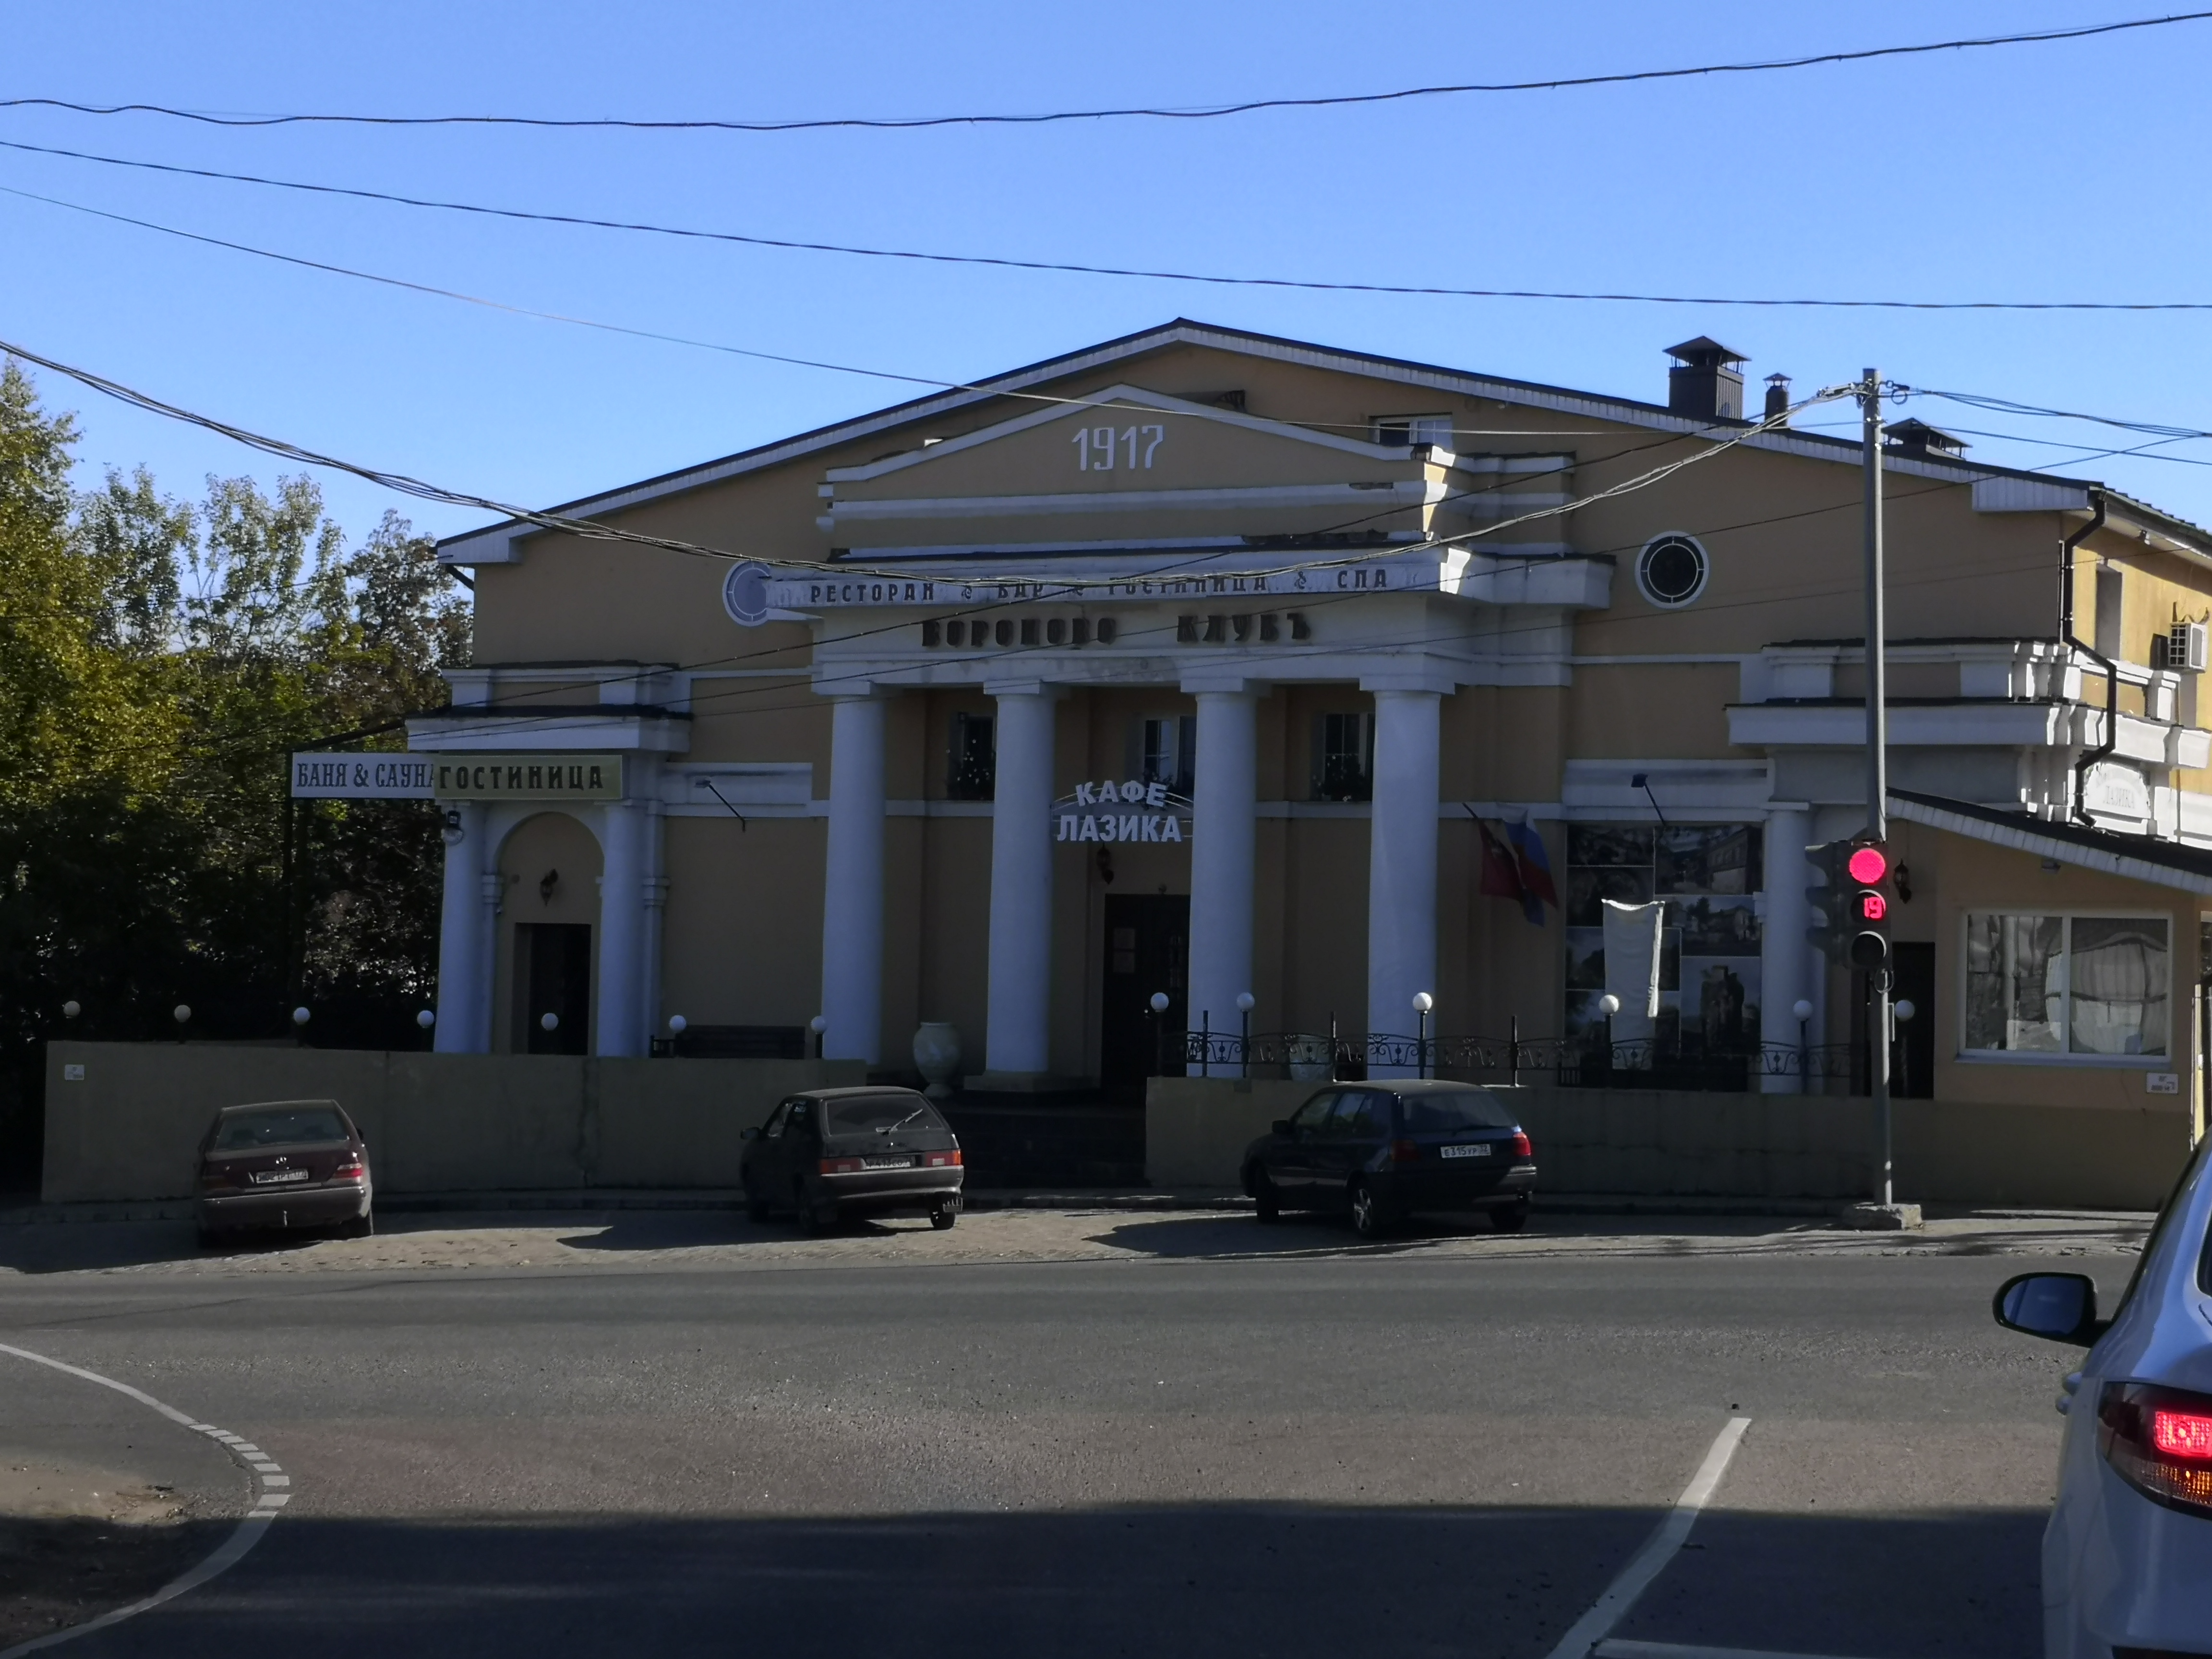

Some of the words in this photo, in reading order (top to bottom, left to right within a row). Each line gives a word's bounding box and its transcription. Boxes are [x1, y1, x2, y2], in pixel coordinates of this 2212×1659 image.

[1071, 425, 1164, 471] 1917
[810, 582, 934, 603] РЕСТОРАН
[1337, 569, 1386, 589] СПА
[922, 617, 1116, 647] ВОРОНОВО
[1177, 613, 1310, 643] КЛУБЪ
[297, 763, 348, 788] БАНЯ
[354, 764, 369, 787] &
[439, 766, 603, 791] ГОСТИНИЦА
[1075, 780, 1167, 807] КАФЕ
[1057, 815, 1182, 842] ЛАЗИКА
[1864, 897, 1883, 919] 19
